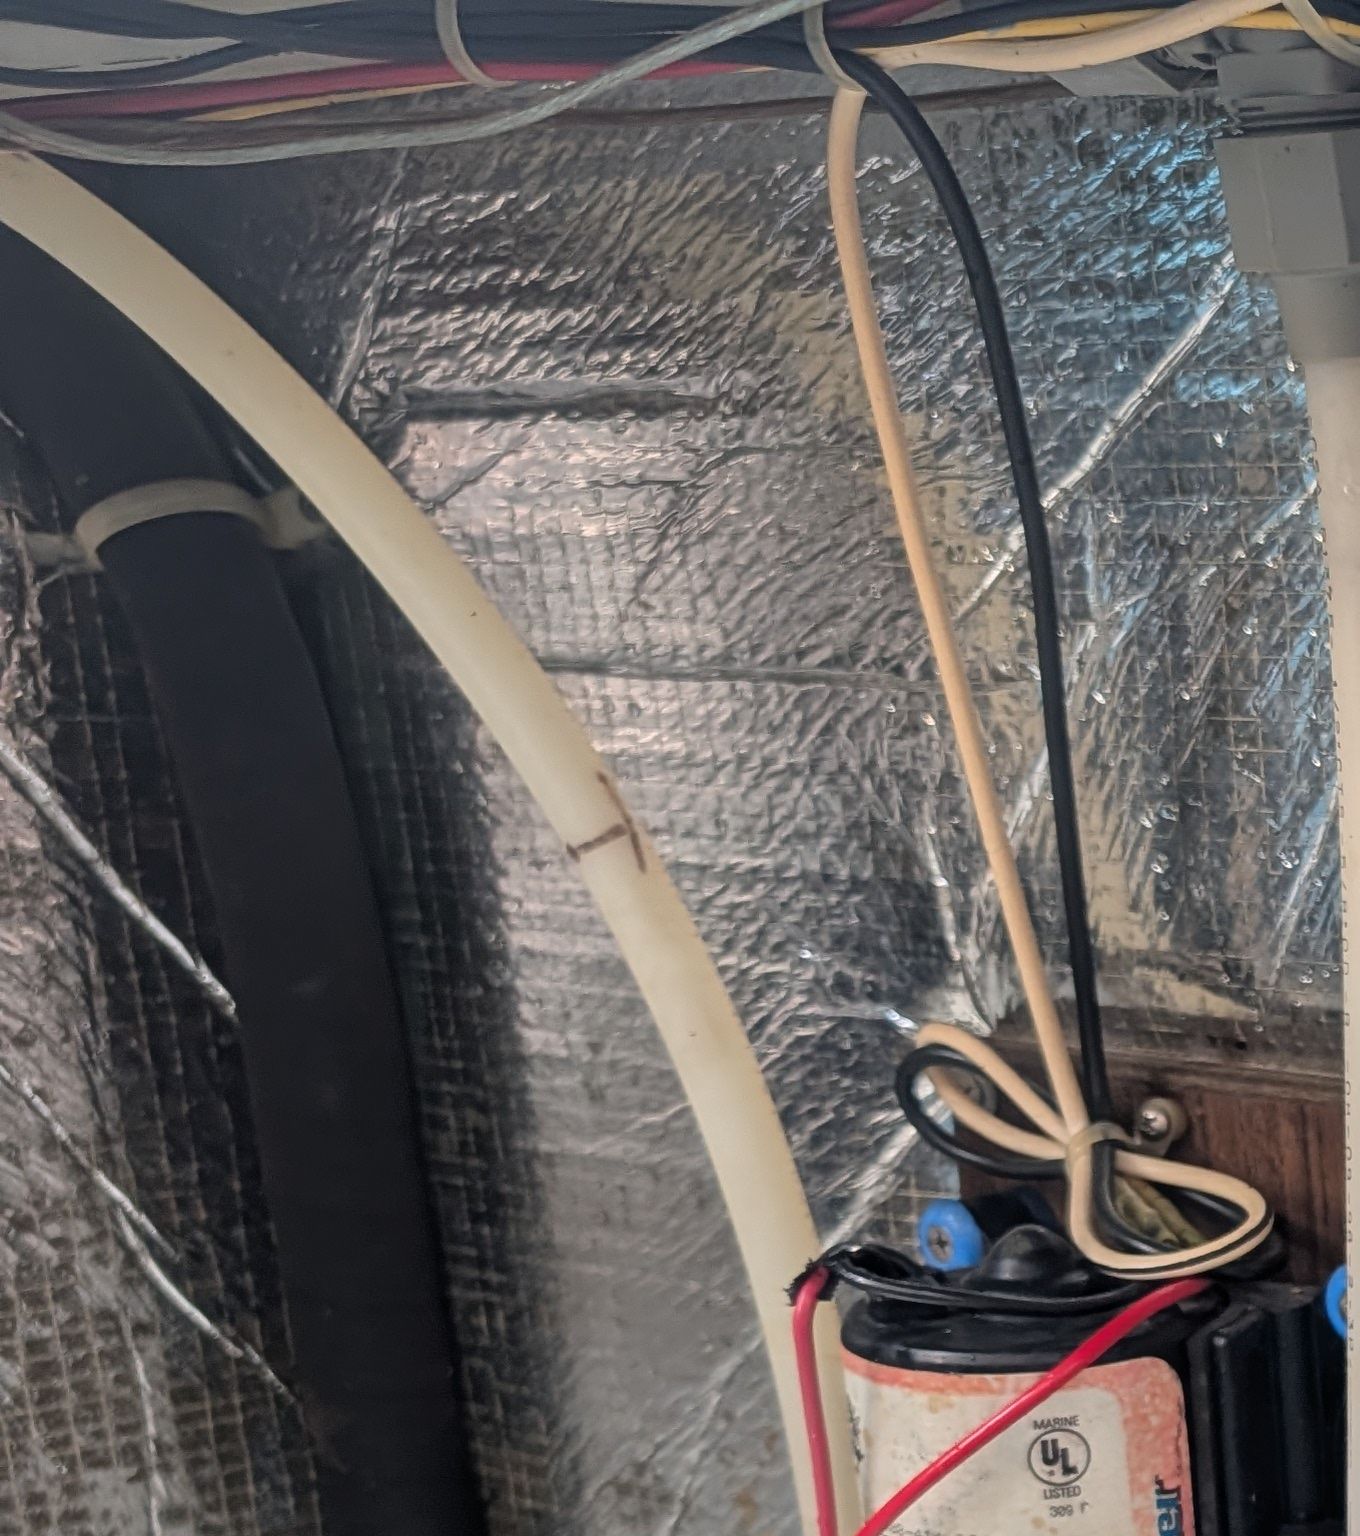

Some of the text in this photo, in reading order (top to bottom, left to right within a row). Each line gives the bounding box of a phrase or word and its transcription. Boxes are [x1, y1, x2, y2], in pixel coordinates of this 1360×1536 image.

[1033, 1416, 1080, 1430] MARINE
[1041, 1439, 1079, 1476] UL
[1043, 1486, 1081, 1500] LISTED
